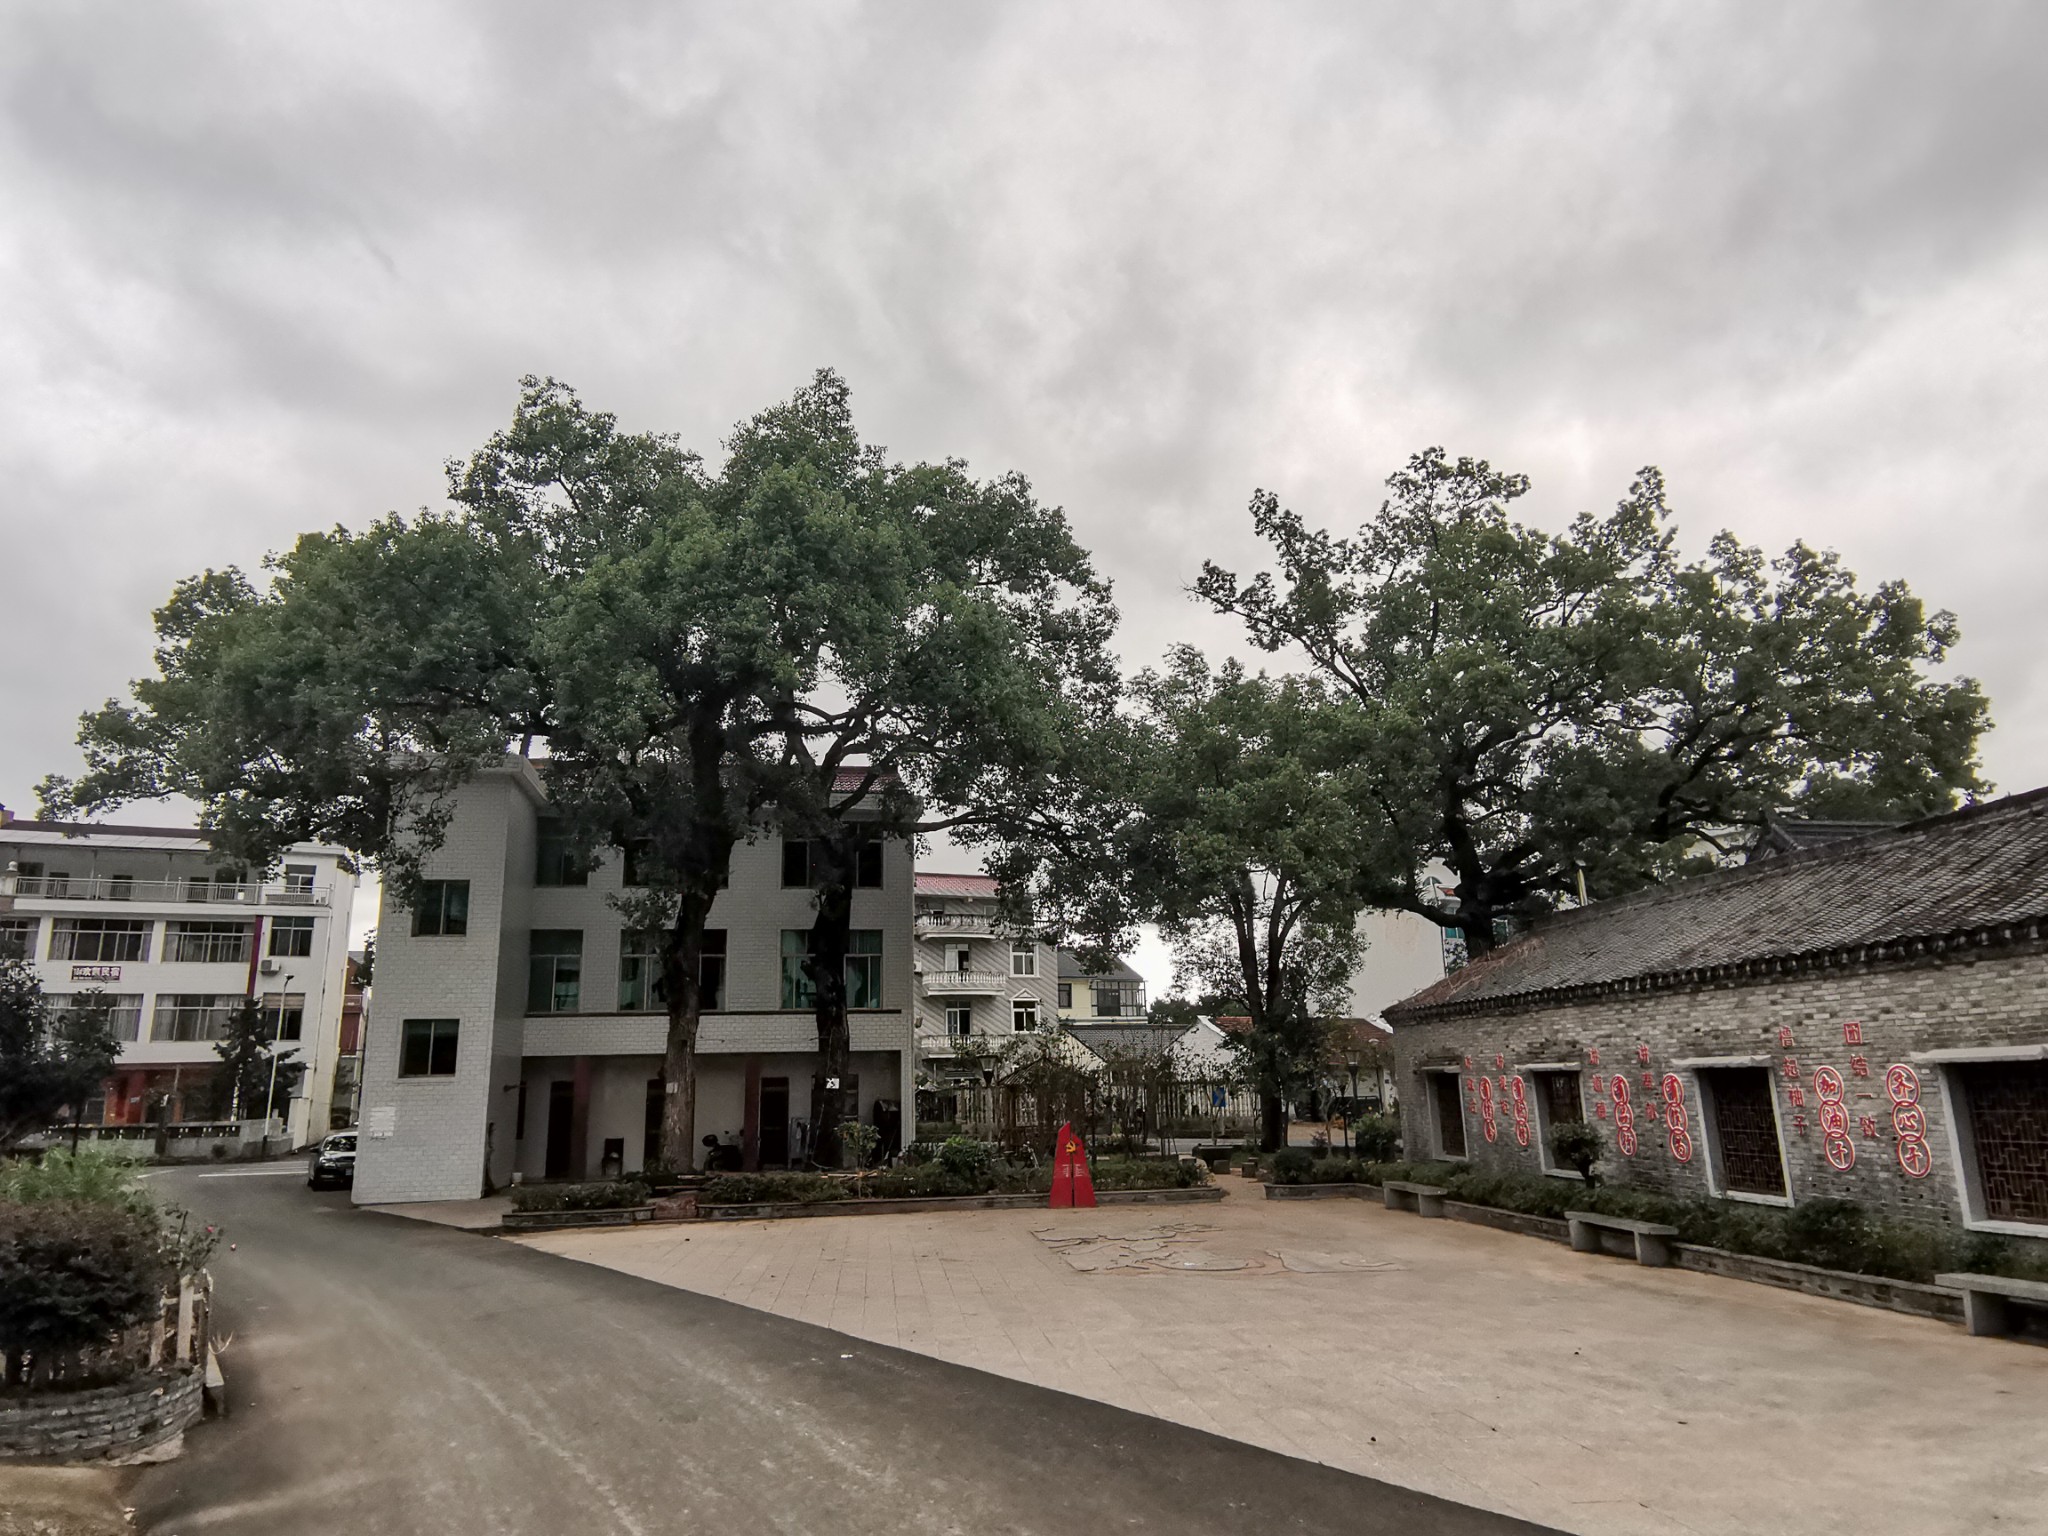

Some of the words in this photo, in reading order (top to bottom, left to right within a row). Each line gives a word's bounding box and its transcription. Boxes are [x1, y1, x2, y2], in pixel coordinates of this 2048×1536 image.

[1778, 1025, 1808, 1136] 撸起袖子
[1817, 1071, 1850, 1168] 加油干
[1843, 1021, 1880, 1138] 团结一致
[1891, 1069, 1925, 1174] 齐心干
